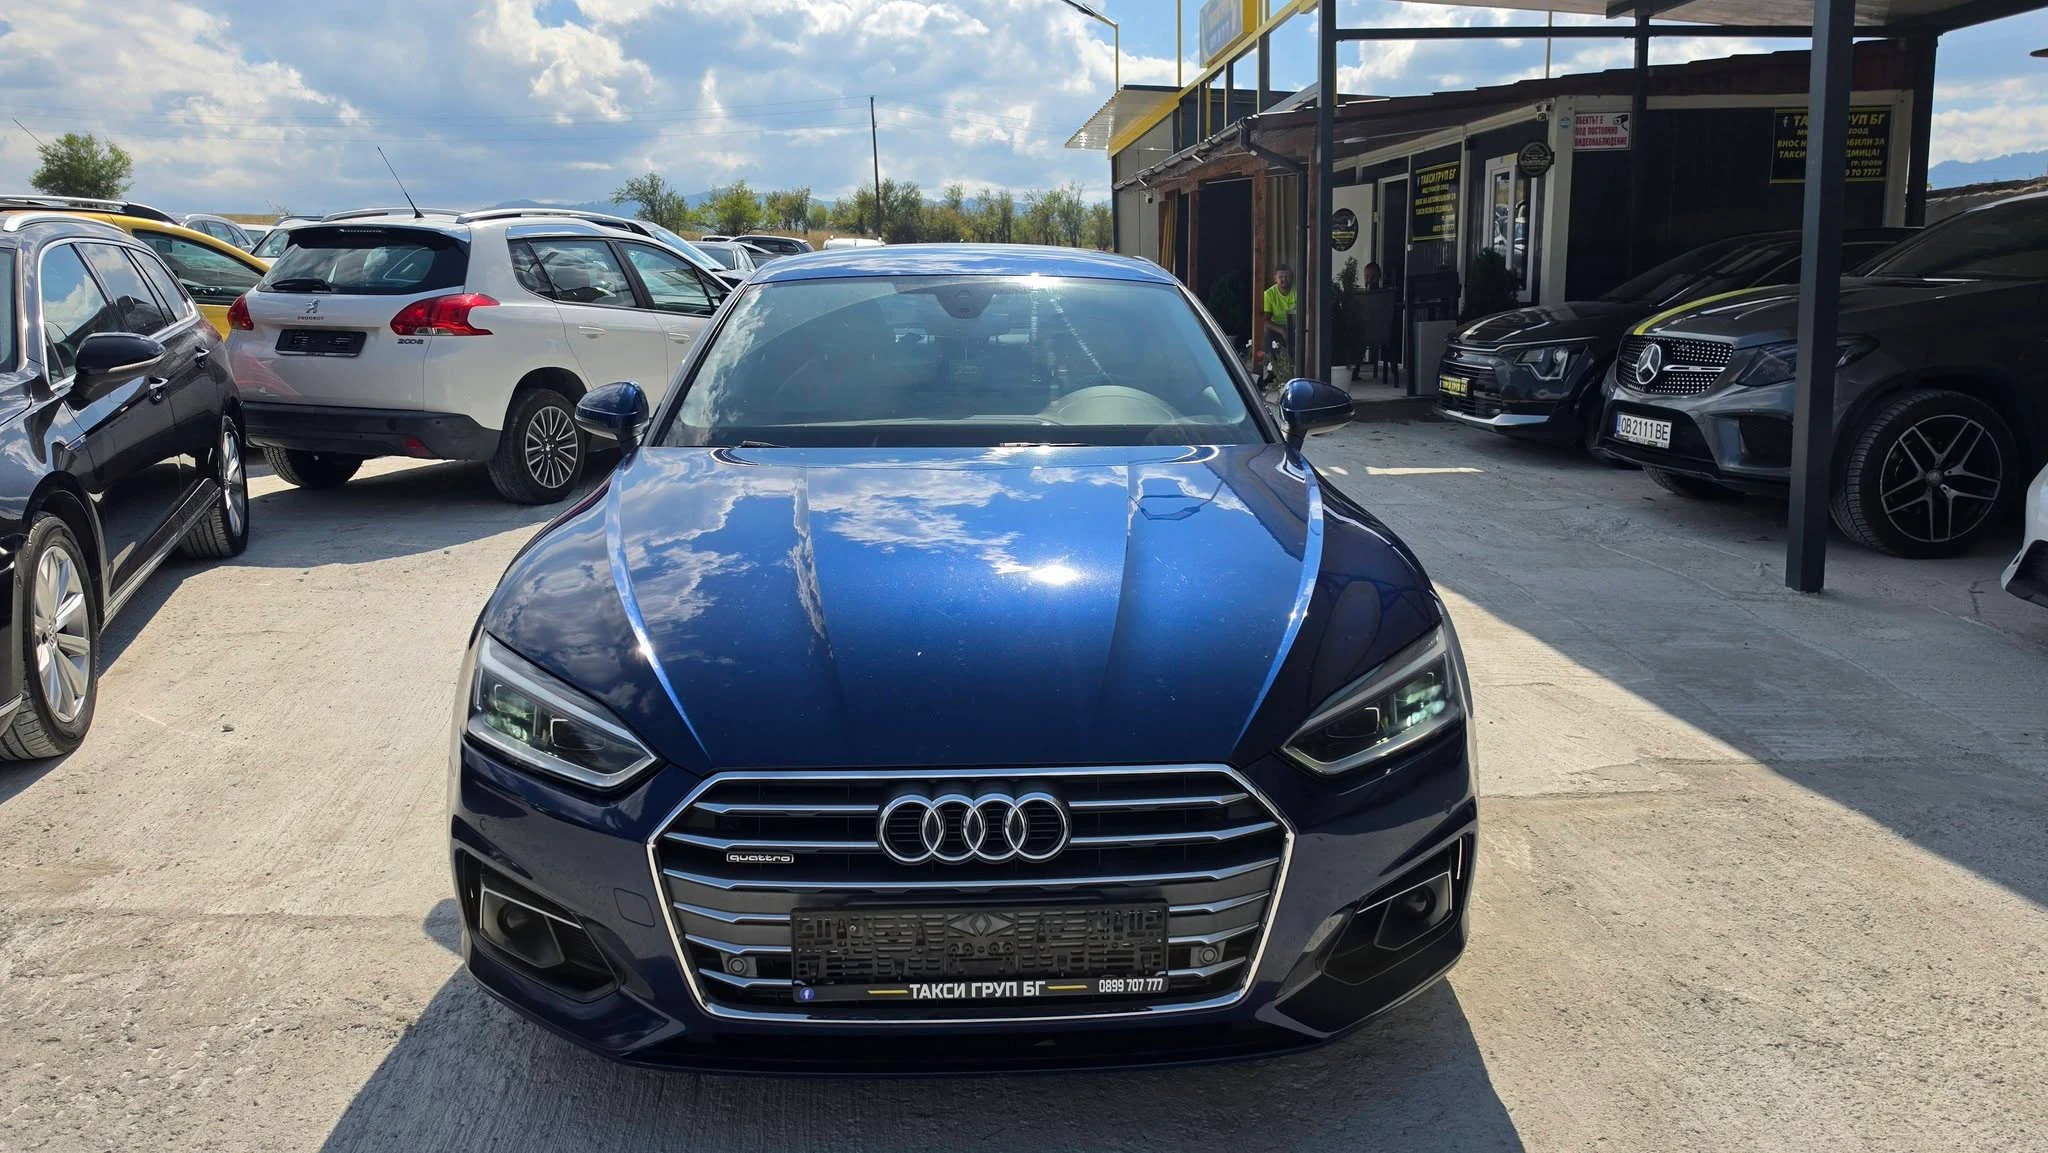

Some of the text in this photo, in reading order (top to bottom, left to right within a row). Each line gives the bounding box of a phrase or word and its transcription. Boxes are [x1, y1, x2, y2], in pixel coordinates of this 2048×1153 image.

[1869, 114, 1886, 125] БГ
[1777, 140, 1799, 148] ВНОС
[1779, 150, 1806, 159] ТАКСИ
[729, 854, 791, 862] quattro
[909, 977, 1163, 999] ТАКСИ ГРУП БГ 0899 707 777
